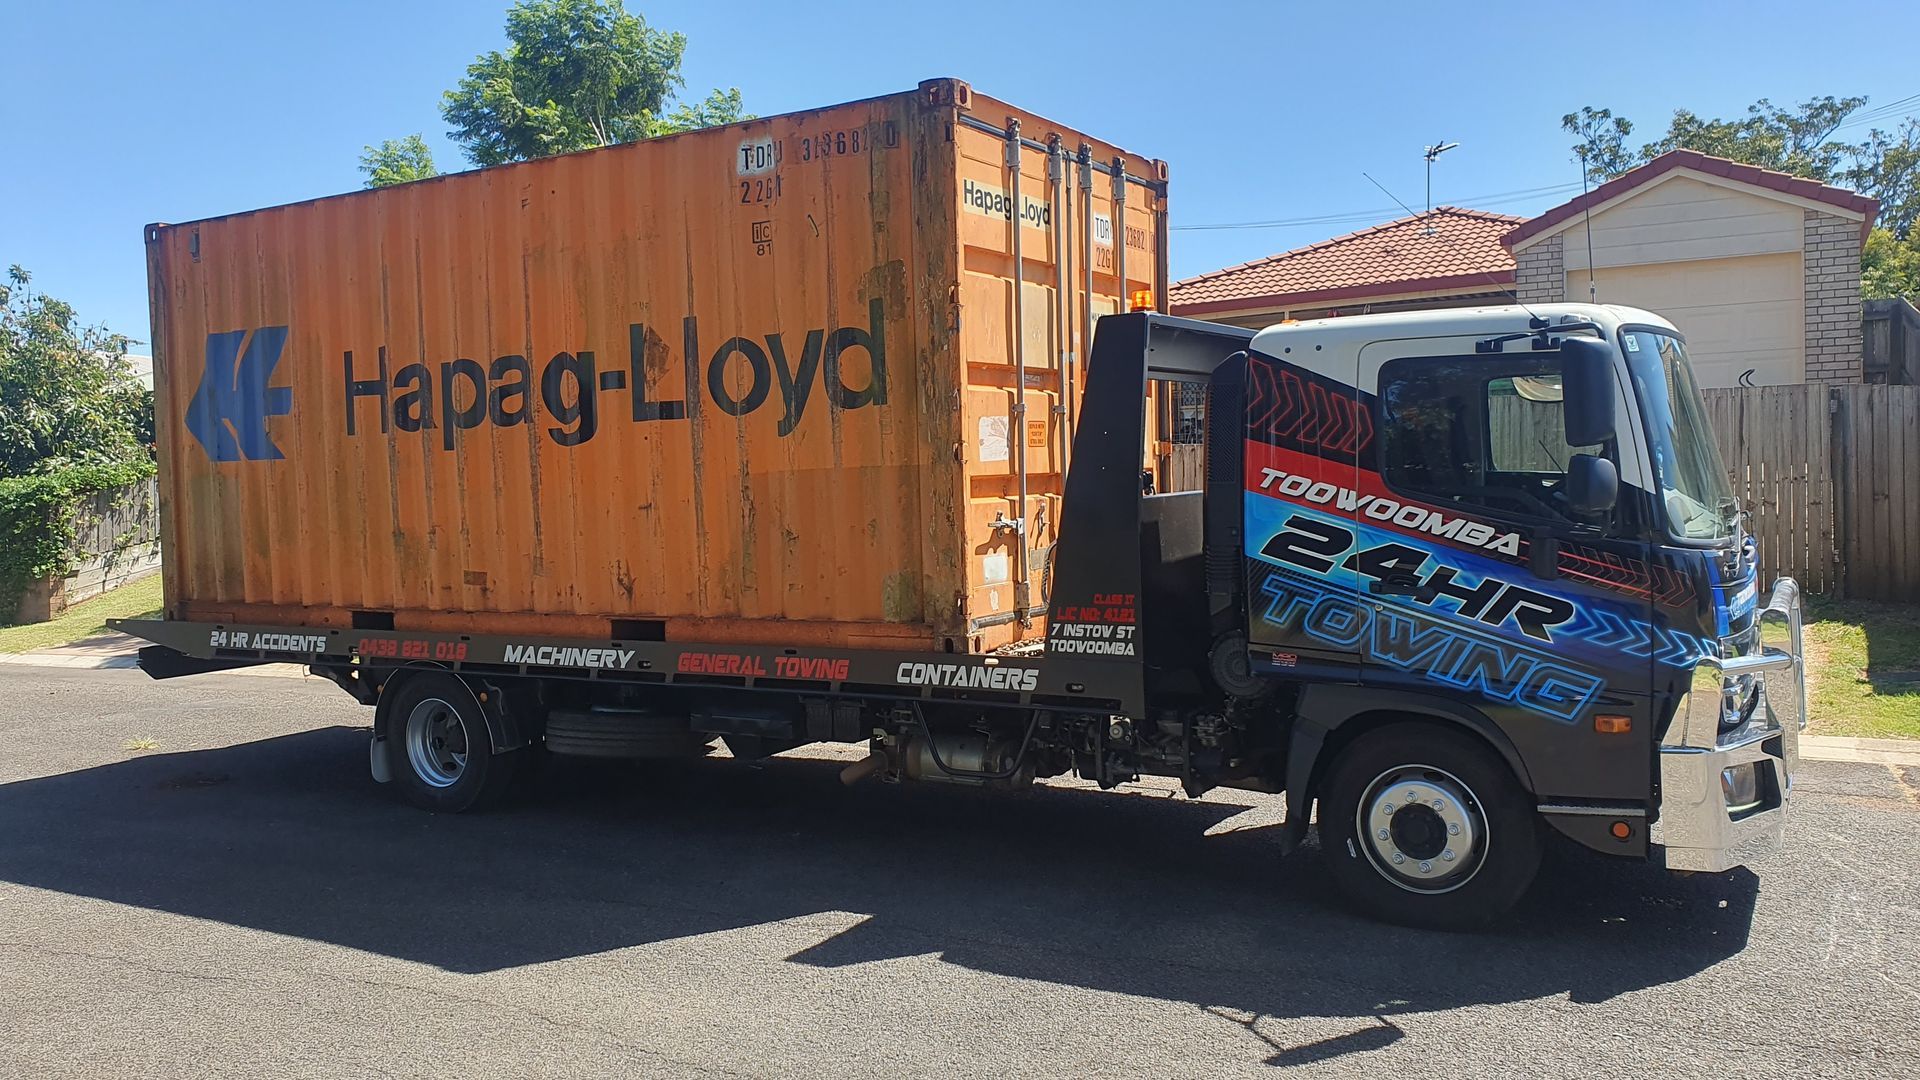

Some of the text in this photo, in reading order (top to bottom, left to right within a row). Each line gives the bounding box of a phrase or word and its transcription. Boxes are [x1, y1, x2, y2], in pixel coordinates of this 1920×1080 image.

[741, 174, 782, 203] 22G1
[963, 179, 1050, 227] Hapagloyd
[1095, 217, 1110, 240] TDR
[1125, 226, 1145, 250] 23682
[756, 243, 772, 256] 81
[1096, 247, 1111, 268] 22G
[343, 298, 888, 450] Hapag-Lloyd
[1259, 466, 1522, 557] TOOWOOMBA
[209, 630, 327, 653] 24 HR ACCIDENTS
[1051, 623, 1135, 639] 7 INSTOW ST
[503, 644, 636, 669] MACHINERY
[1050, 639, 1135, 656] TOOWOOMBA
[1260, 573, 1604, 721] TOWING
[677, 652, 850, 680] GENERAL TOWING
[896, 662, 1040, 691] CONTAINERS
